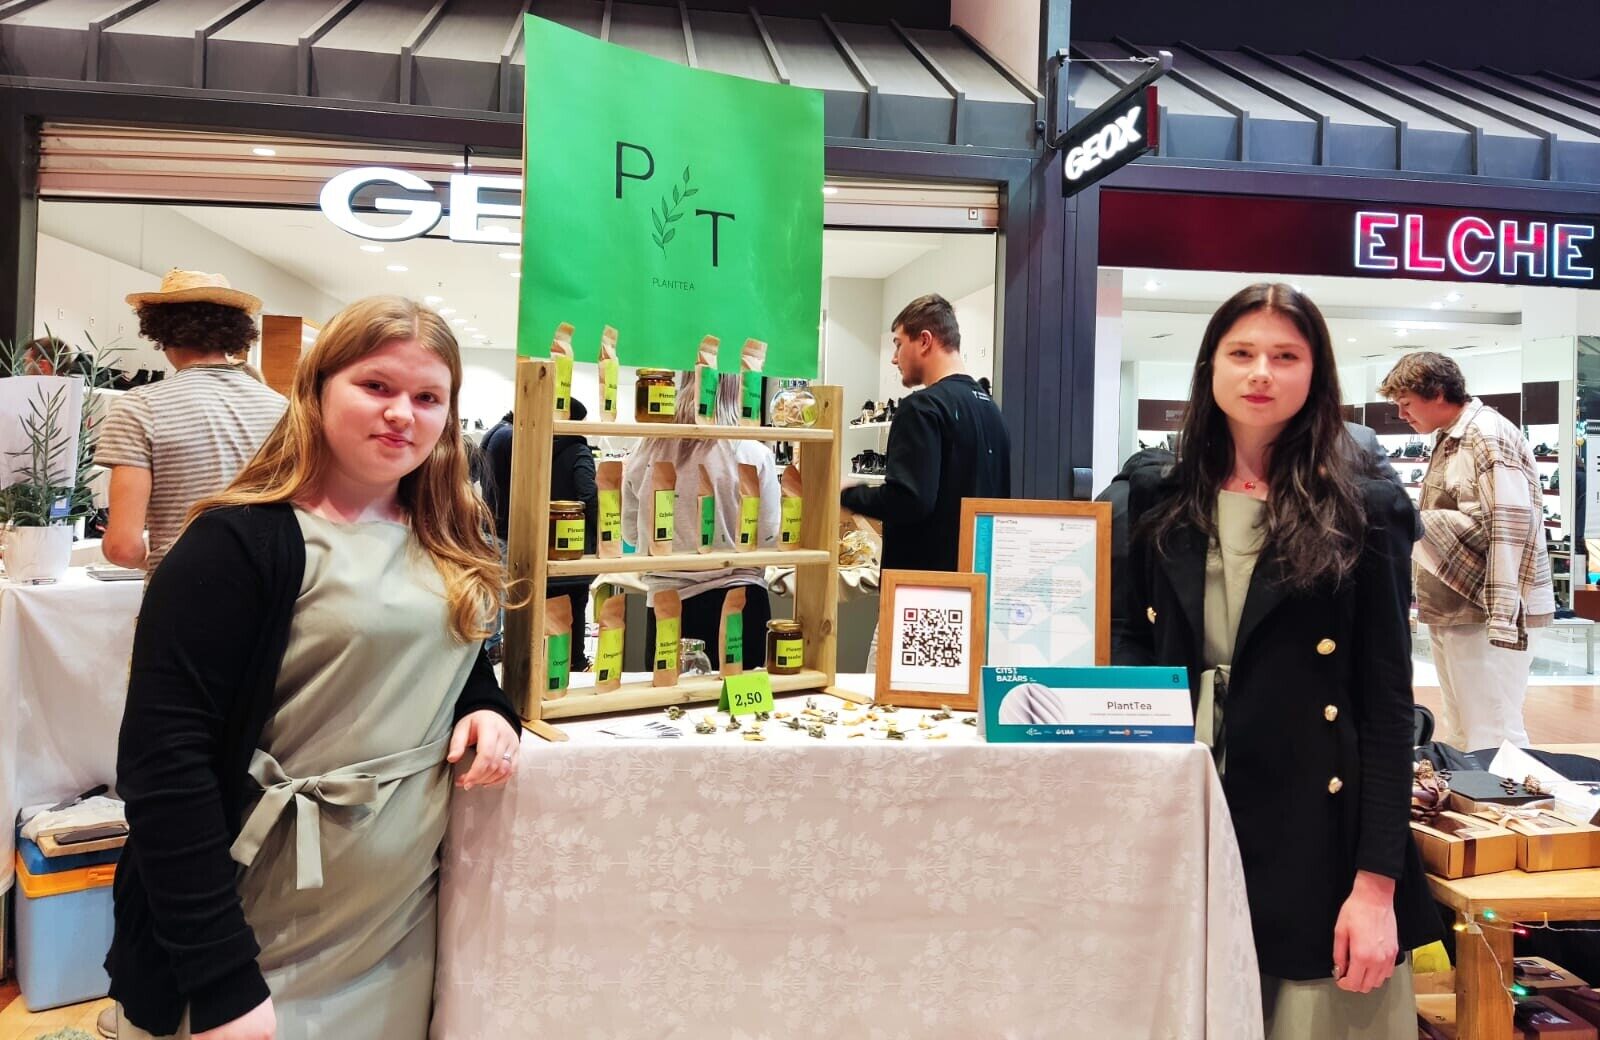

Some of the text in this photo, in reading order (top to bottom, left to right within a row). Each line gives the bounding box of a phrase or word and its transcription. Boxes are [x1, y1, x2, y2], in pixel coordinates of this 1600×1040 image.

[616, 141, 655, 199] P
[1065, 106, 1141, 180] GEOX
[695, 208, 736, 267] T
[1354, 210, 1595, 280] ELCHE
[734, 691, 763, 707] 2,50
[1107, 701, 1152, 711] PlantTea
[1172, 674, 1180, 684] 8
